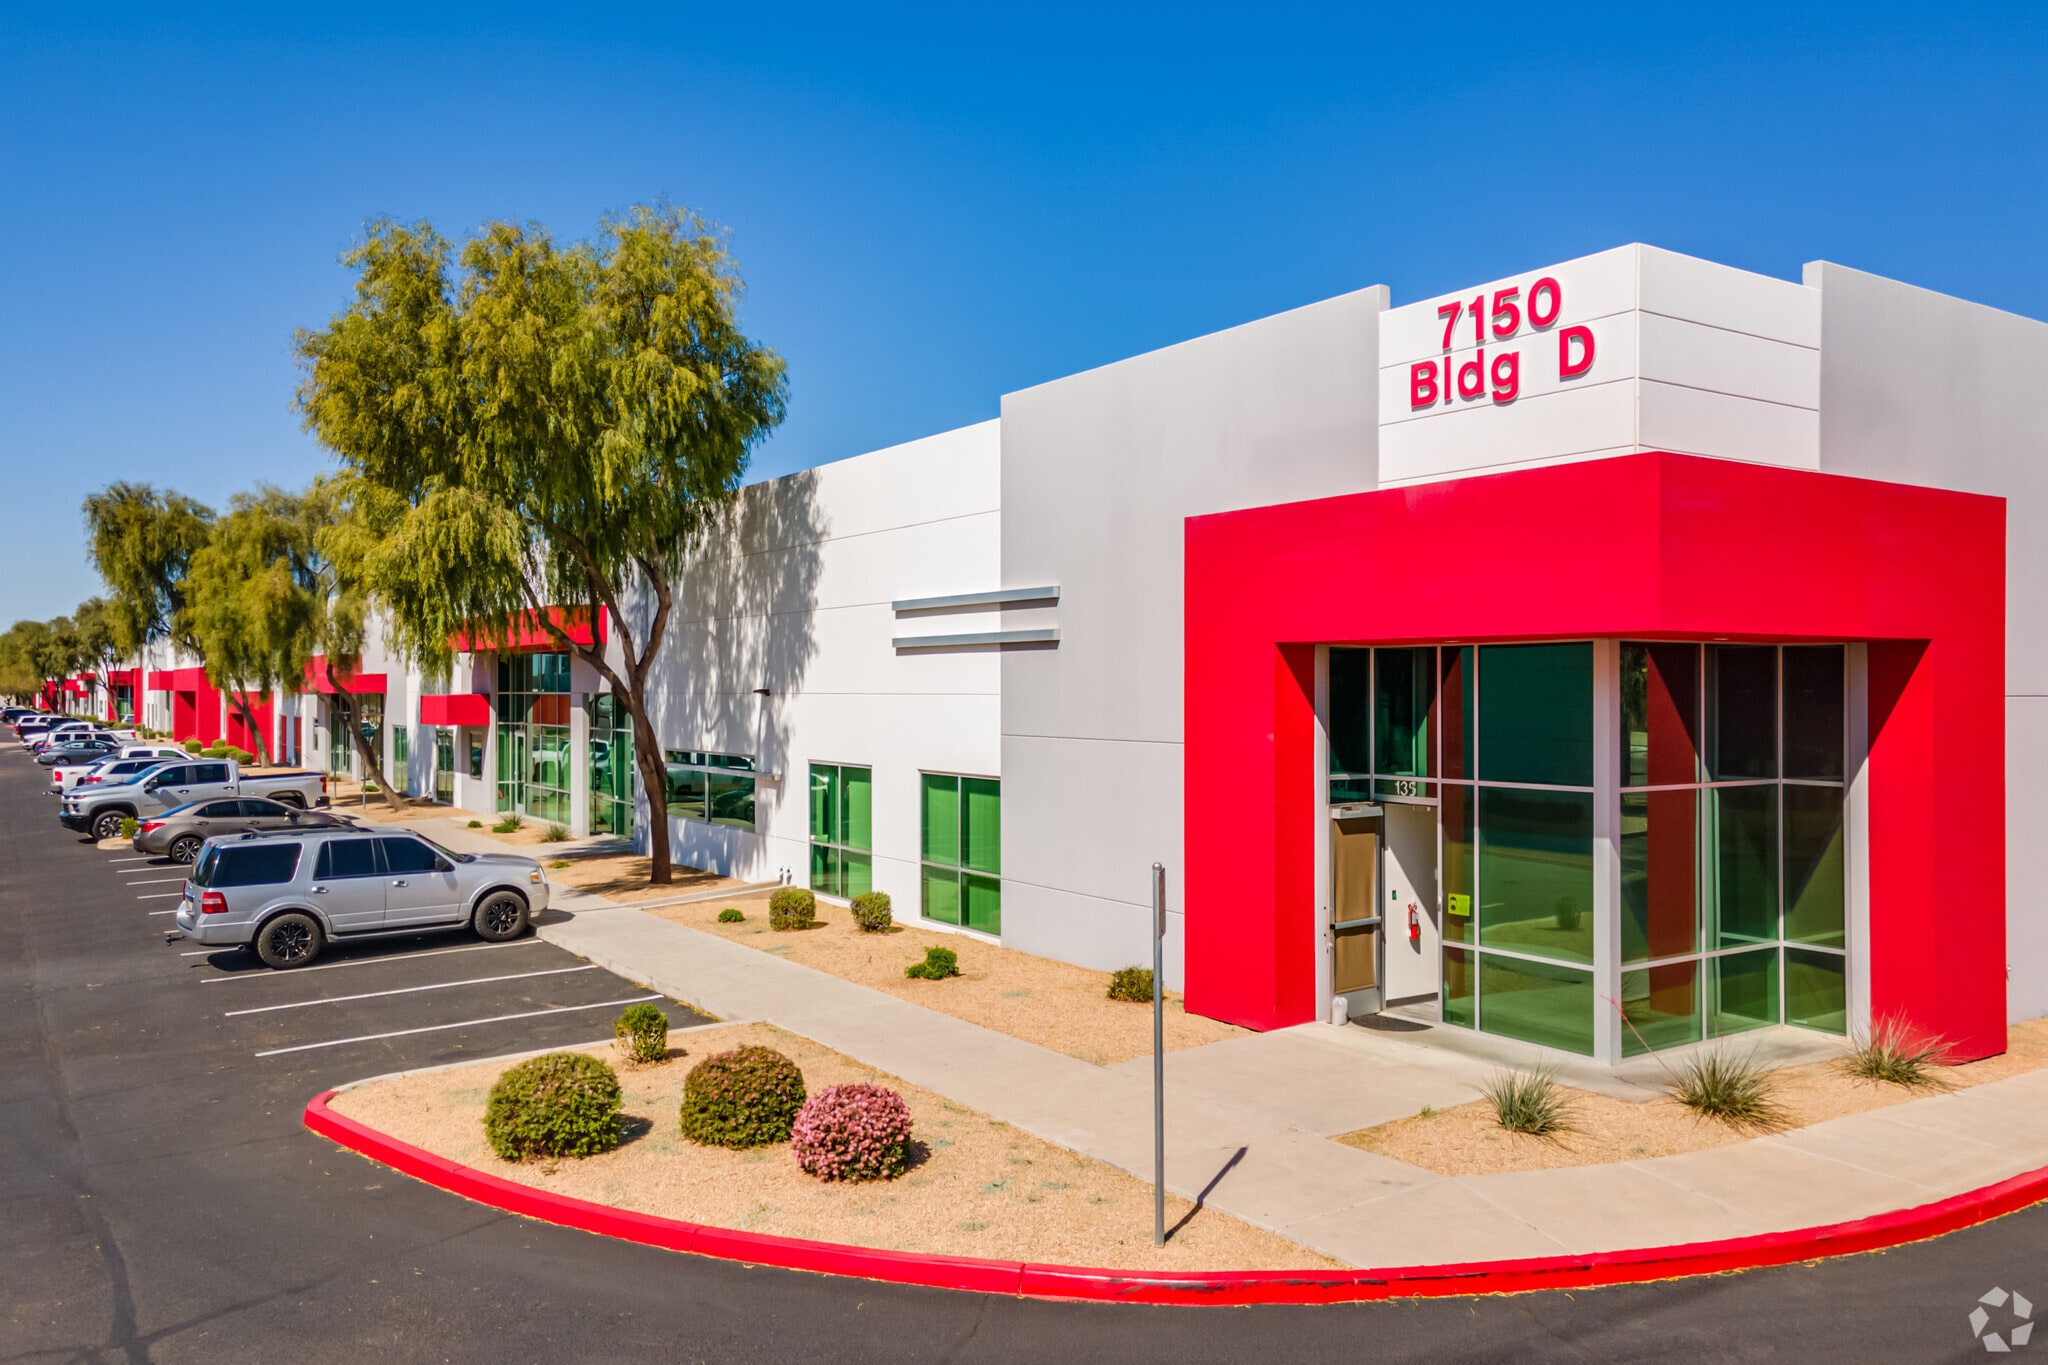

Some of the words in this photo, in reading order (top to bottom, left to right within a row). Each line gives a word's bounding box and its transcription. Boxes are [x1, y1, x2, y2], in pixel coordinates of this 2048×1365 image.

[1438, 277, 1562, 351] 7150
[1410, 348, 1520, 408] Bldg
[1559, 325, 1596, 379] D
[1395, 780, 1417, 797] 135
